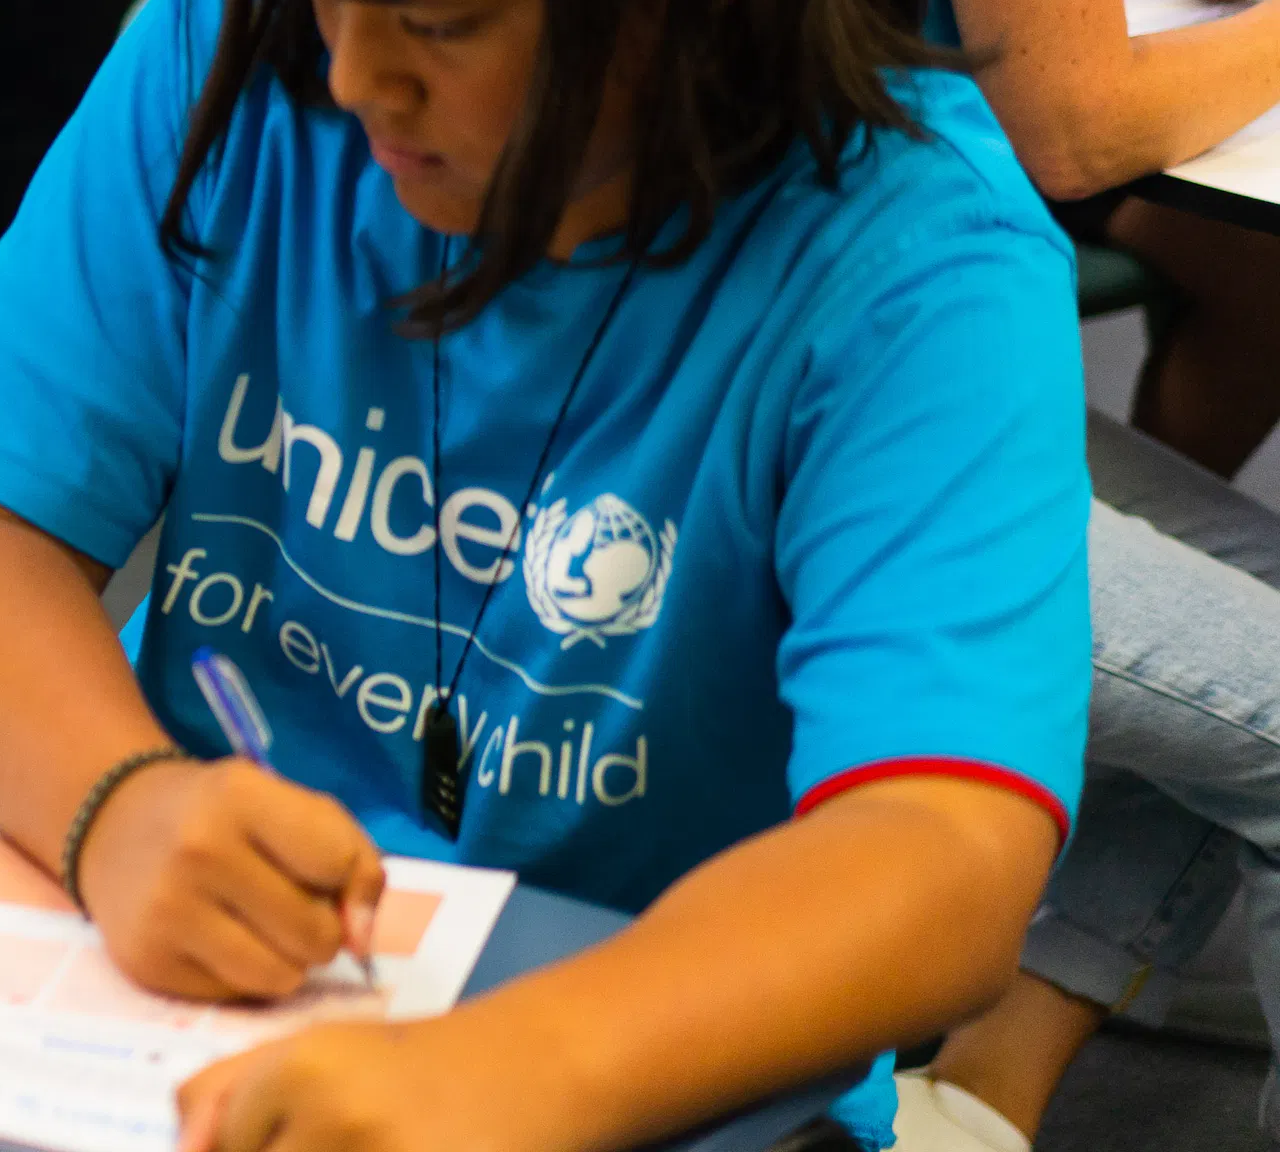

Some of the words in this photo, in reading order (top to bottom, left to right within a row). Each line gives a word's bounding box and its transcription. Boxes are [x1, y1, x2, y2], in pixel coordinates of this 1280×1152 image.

[216, 373, 538, 585] unice
[161, 548, 273, 633] for
[279, 619, 488, 773] every
[477, 715, 647, 805] child
